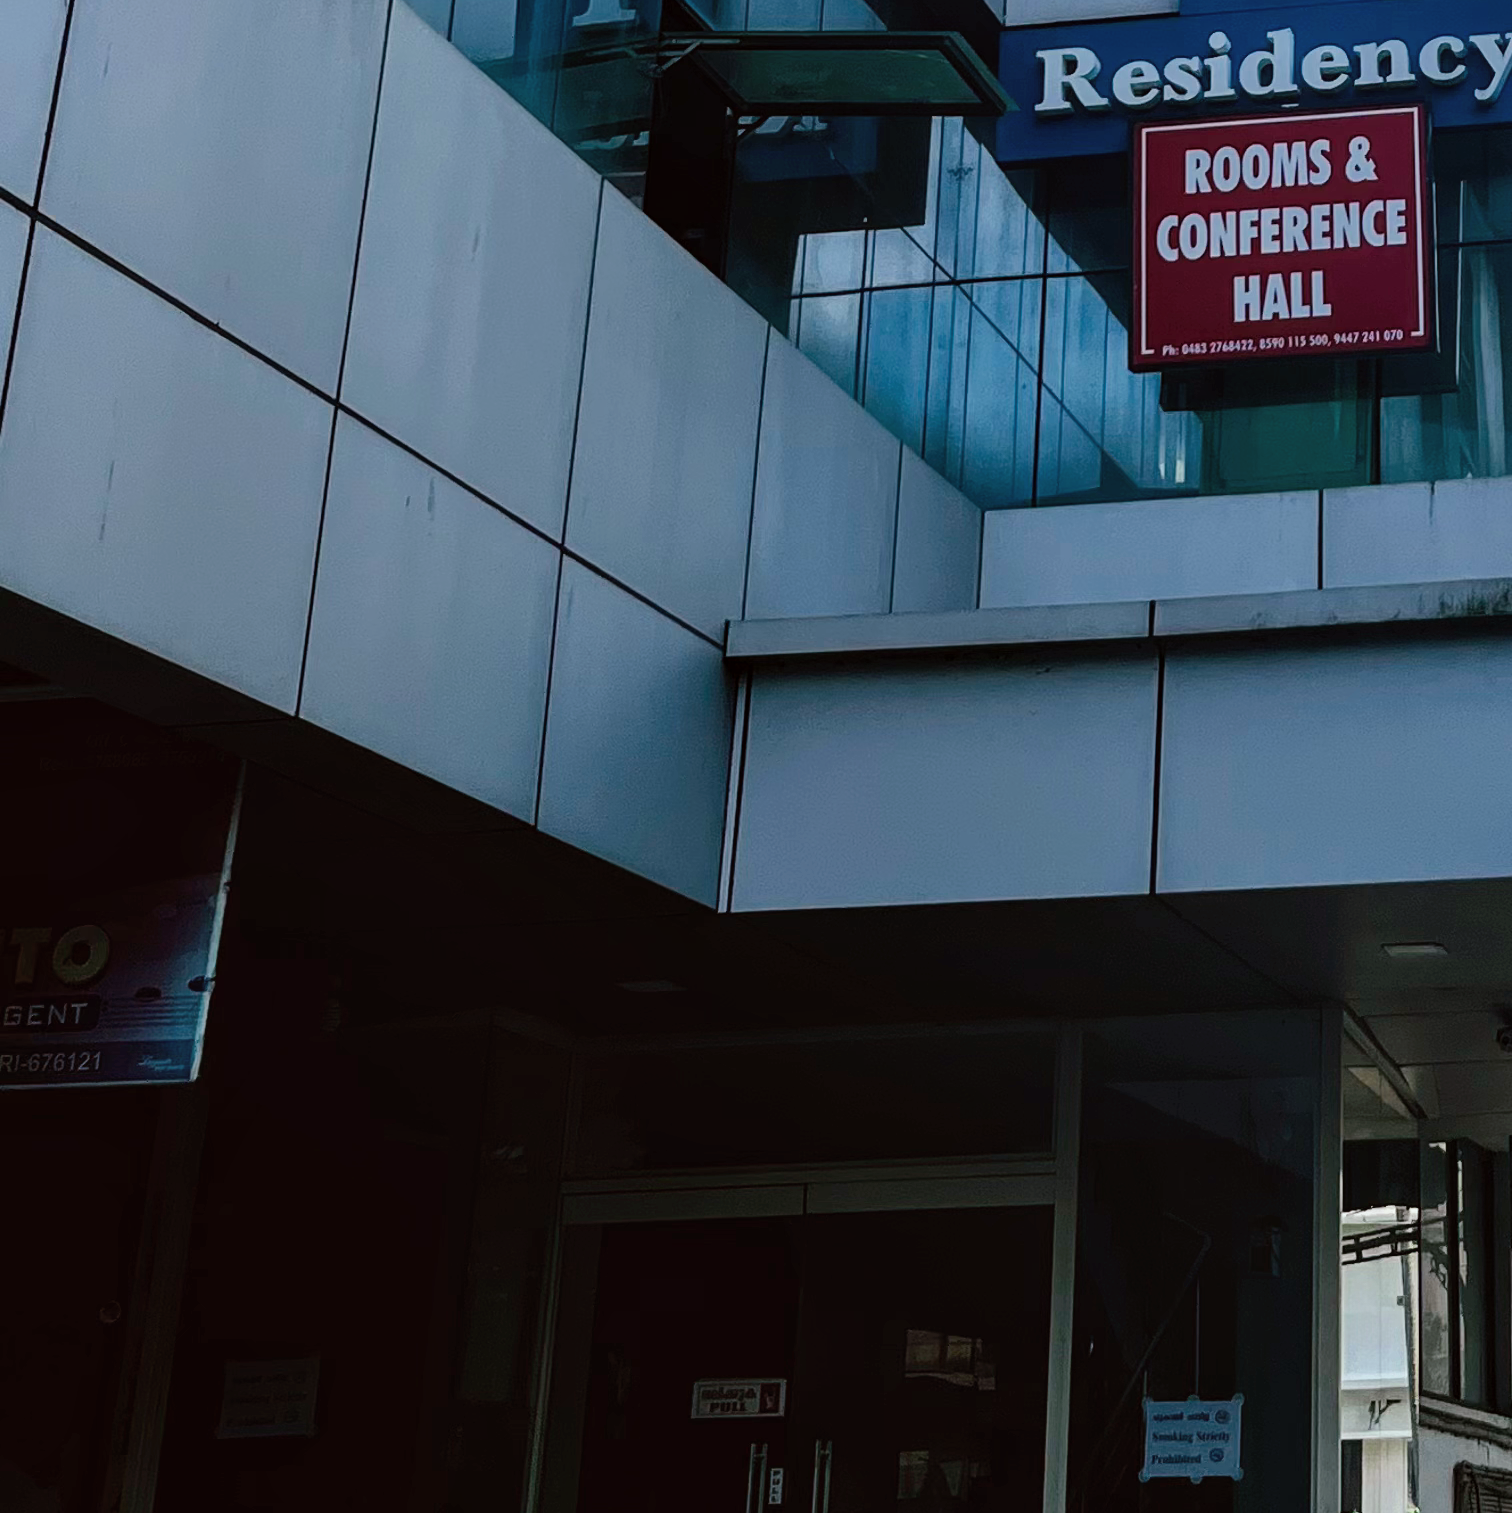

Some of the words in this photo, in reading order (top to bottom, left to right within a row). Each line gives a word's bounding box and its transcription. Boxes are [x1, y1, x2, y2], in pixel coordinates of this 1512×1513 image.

[1185, 139, 1332, 194] ROOMS
[1345, 135, 1378, 182] &
[1156, 199, 1407, 262] CONFERENCE
[1233, 270, 1332, 322] HALL
[1162, 345, 1179, 356] Ph:
[1182, 343, 1207, 355] 0483
[1334, 332, 1360, 345] 9447
[1362, 331, 1381, 343] 241
[1383, 330, 1404, 342] 070
[0, 925, 109, 986] TO
[709, 1401, 747, 1413] PULL
